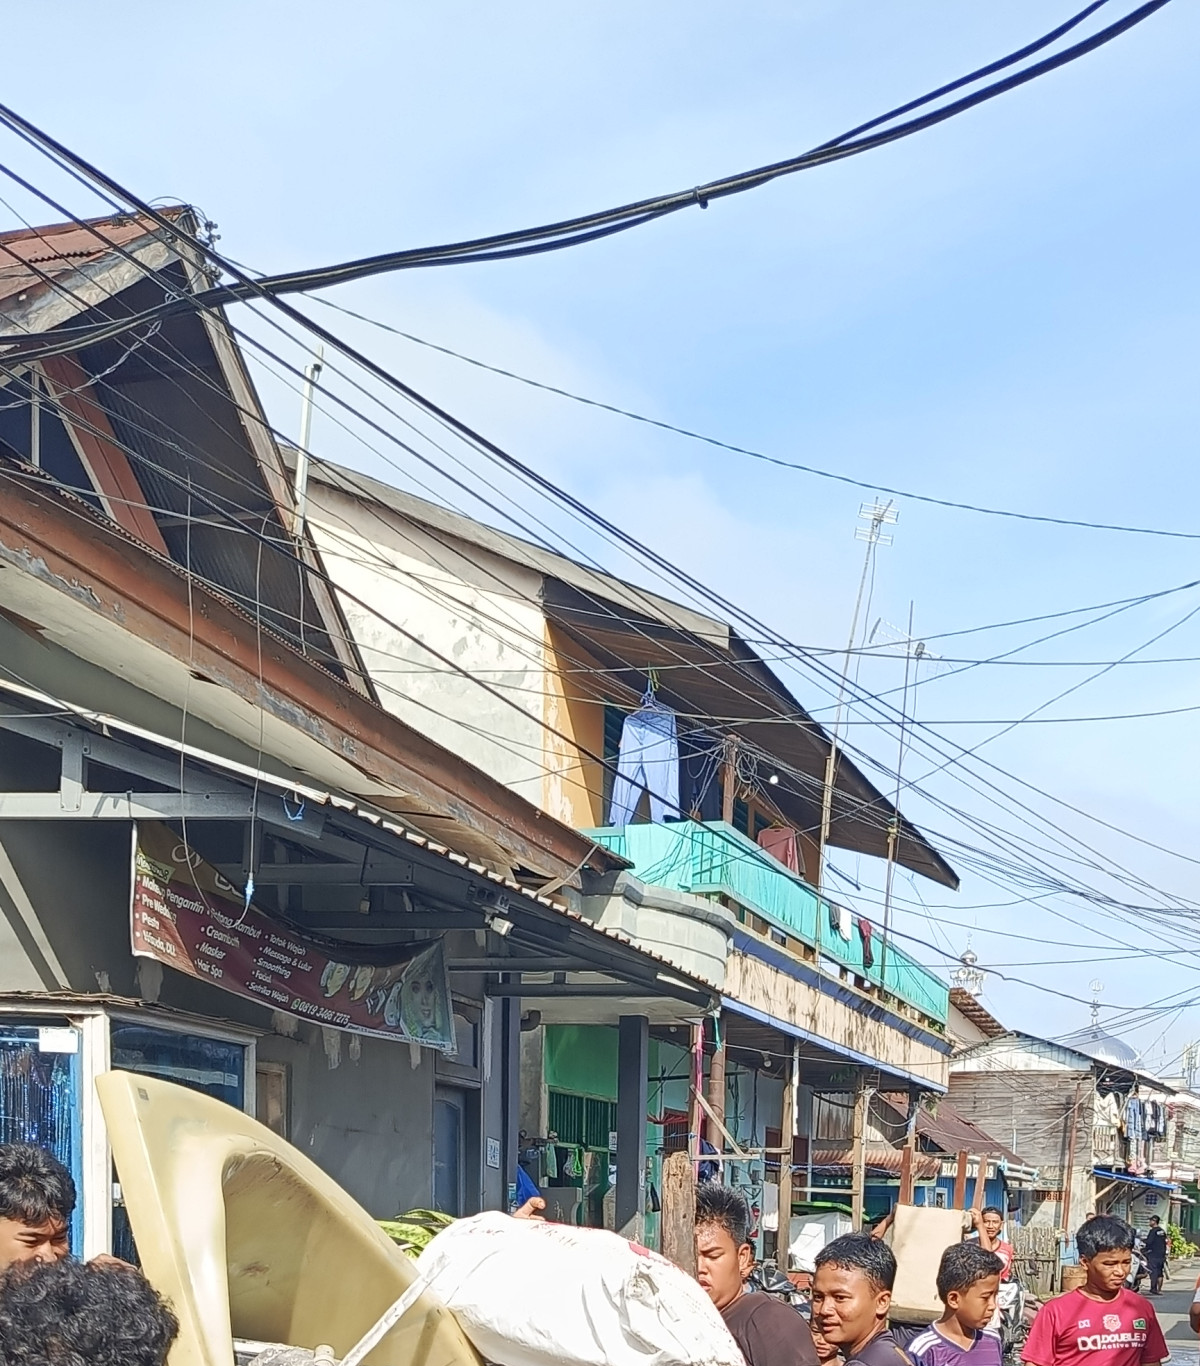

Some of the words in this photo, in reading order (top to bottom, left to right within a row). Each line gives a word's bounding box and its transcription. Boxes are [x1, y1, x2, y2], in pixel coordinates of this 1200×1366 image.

[166, 888, 204, 914] Pengantin
[199, 942, 226, 959] Masker
[287, 941, 306, 956] Wajah
[197, 958, 211, 972] Hair
[211, 965, 223, 979] Spa
[256, 957, 291, 979] Smoothing
[299, 1001, 318, 1015] 0819
[942, 1163, 958, 1177] BLO
[1101, 1332, 1141, 1343] DOUBLE
